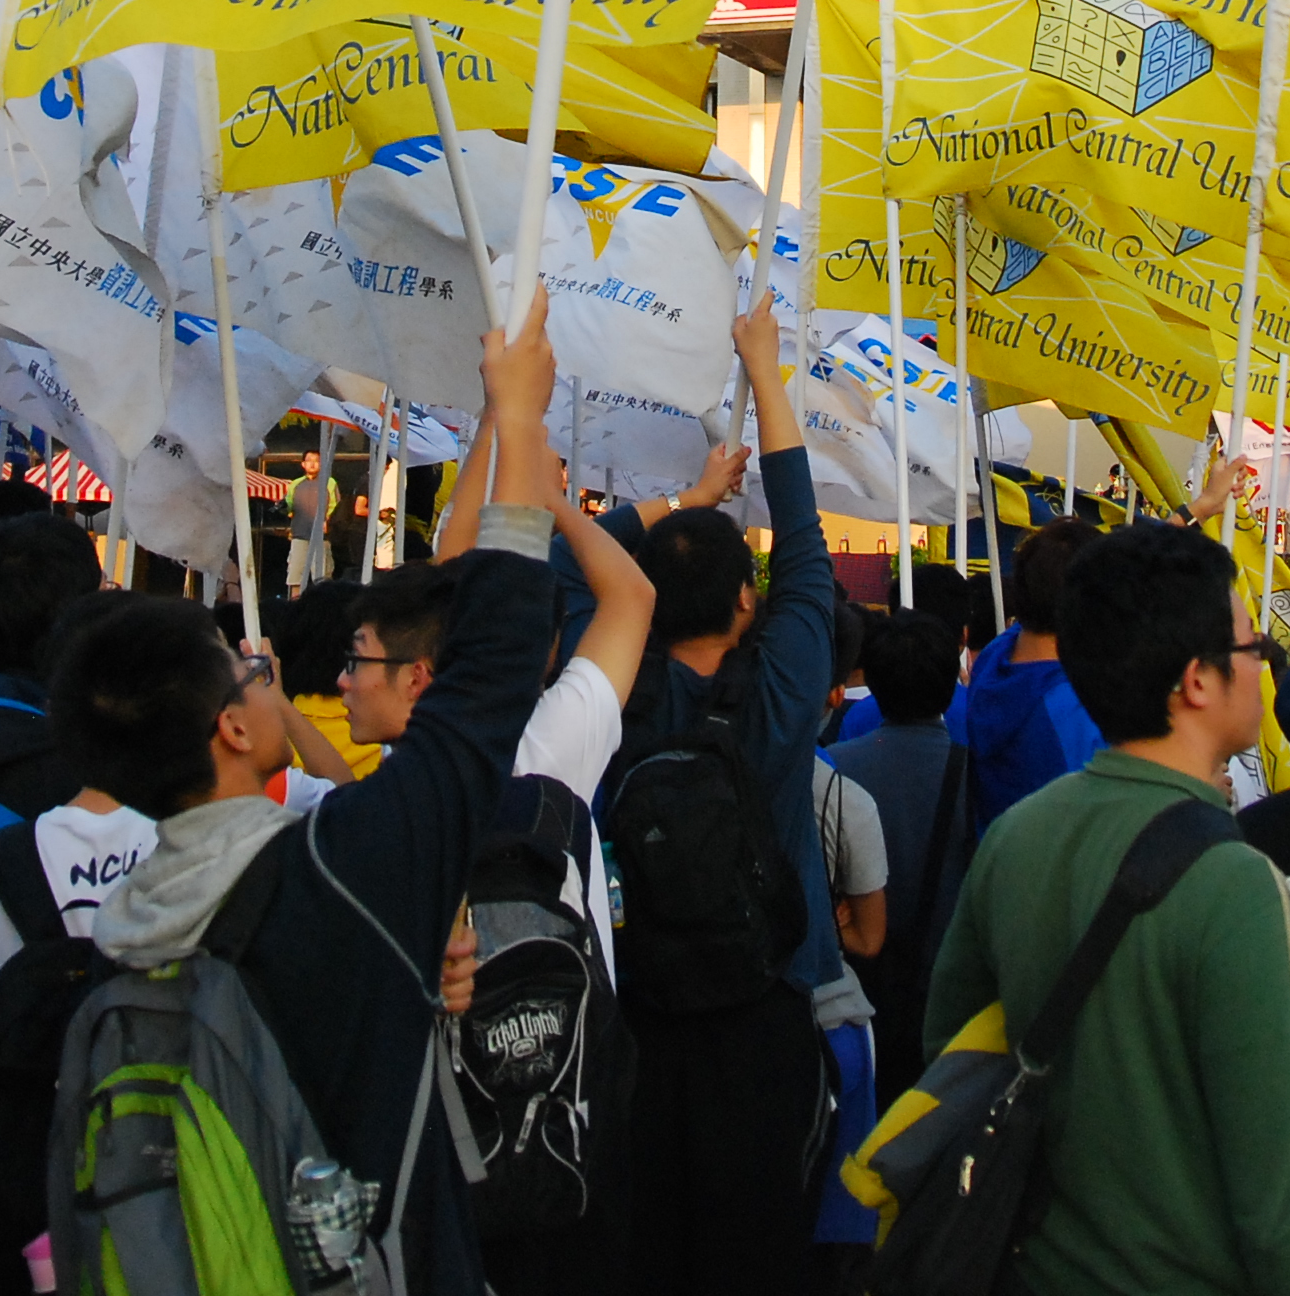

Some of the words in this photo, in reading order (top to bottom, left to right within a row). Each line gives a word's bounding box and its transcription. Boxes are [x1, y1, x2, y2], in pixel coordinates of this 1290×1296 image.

[886, 109, 1055, 168] National
[1065, 107, 1182, 181] Central
[1111, 234, 1213, 312] Central
[1033, 312, 1210, 416] University
[70, 848, 139, 887] NCU
